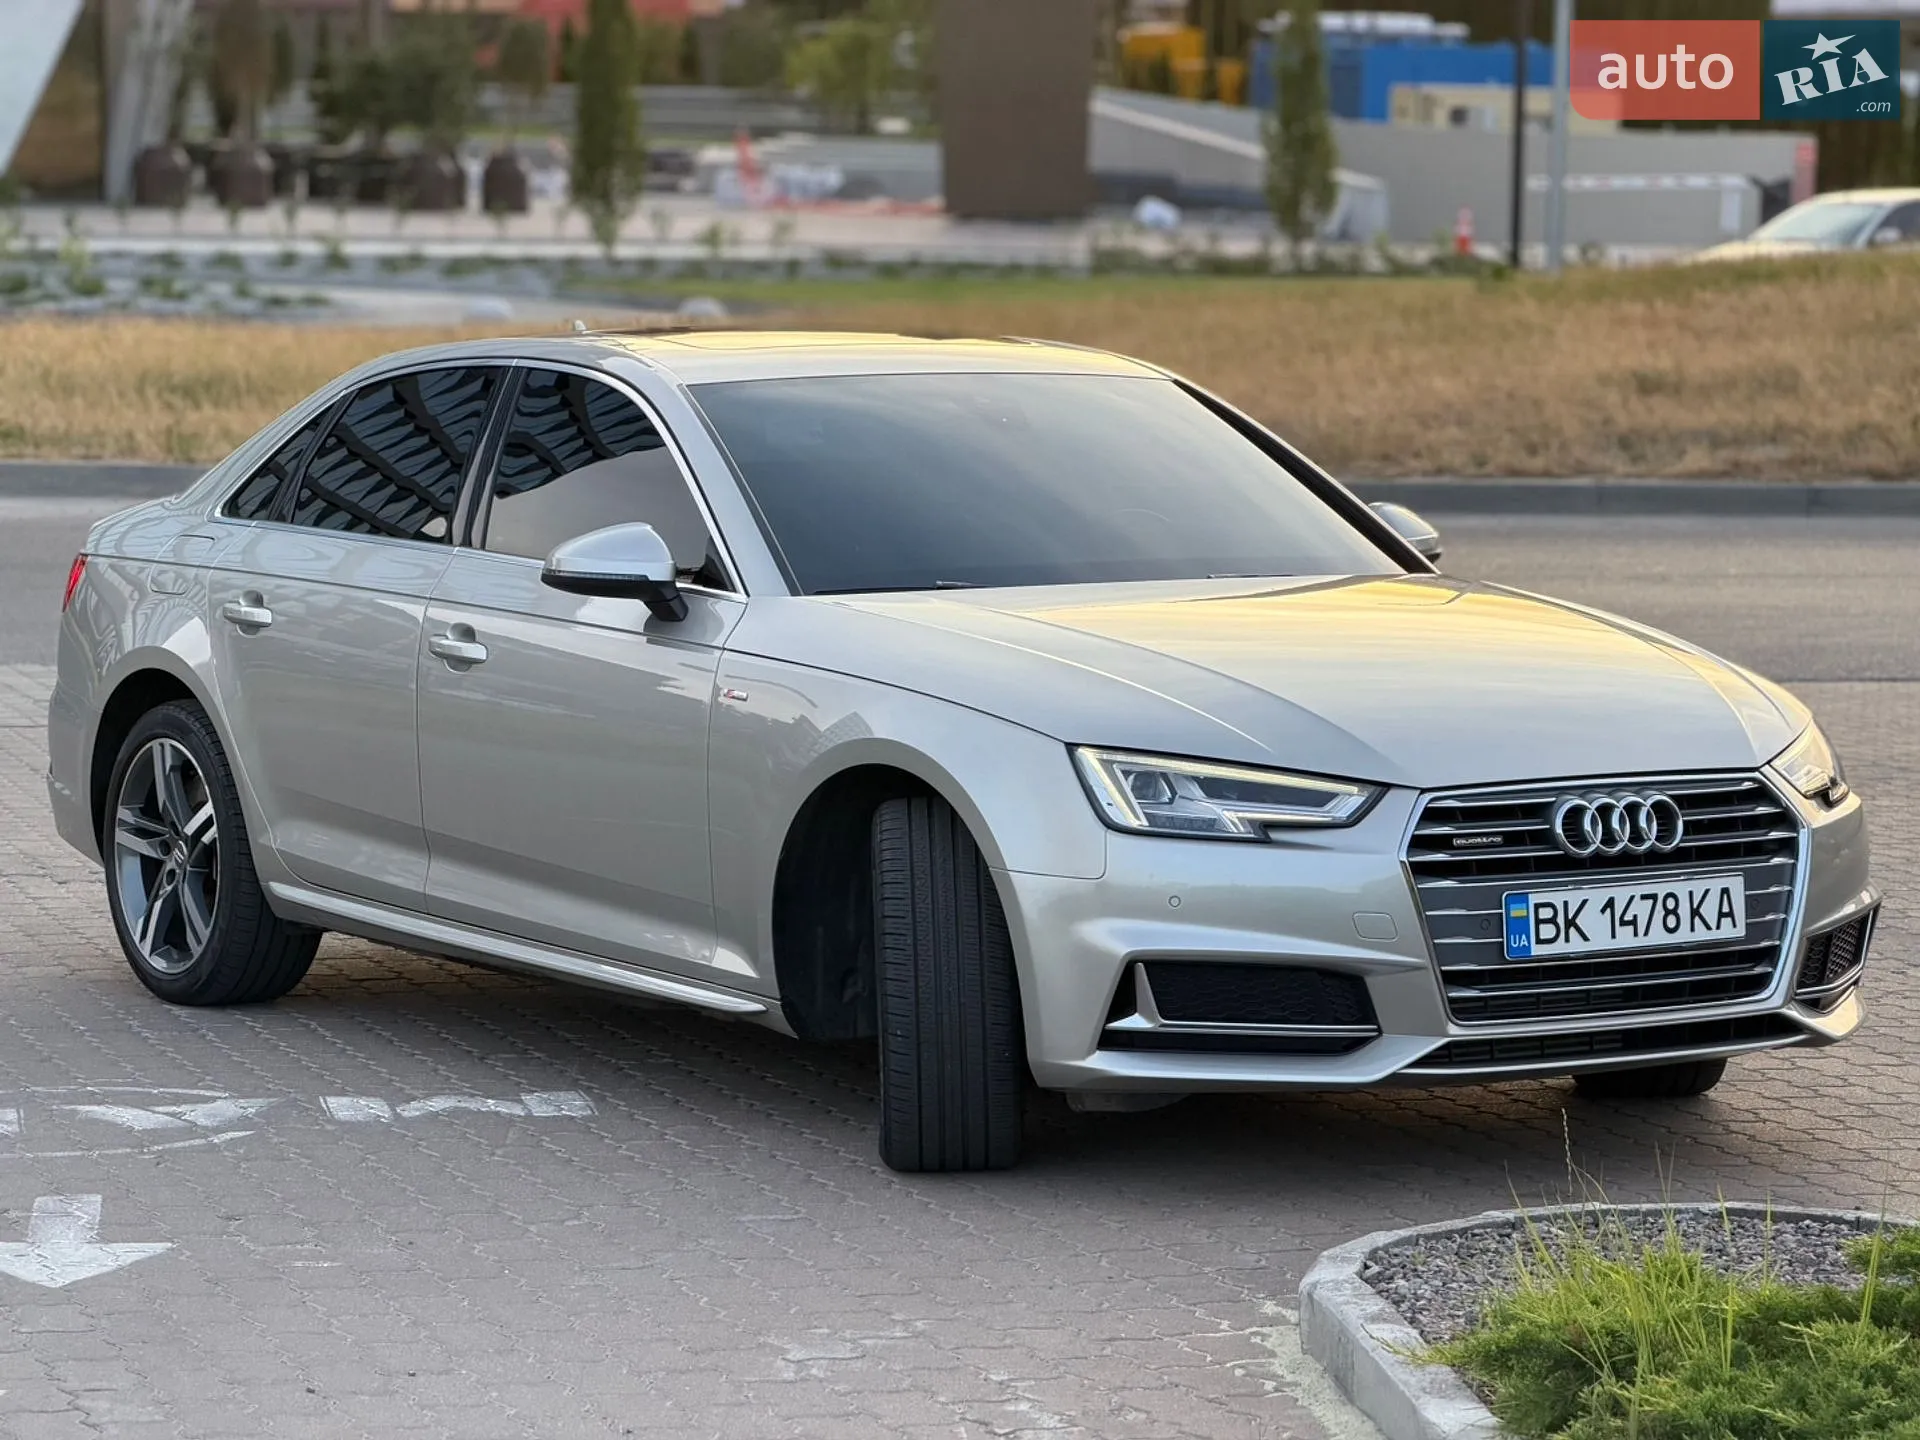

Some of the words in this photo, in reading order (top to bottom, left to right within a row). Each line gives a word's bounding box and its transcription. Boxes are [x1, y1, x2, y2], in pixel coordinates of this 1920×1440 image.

[1533, 898, 1591, 946] BK
[1600, 892, 1682, 940] 1478
[1689, 887, 1738, 933] KA
[1510, 934, 1529, 948] UA
